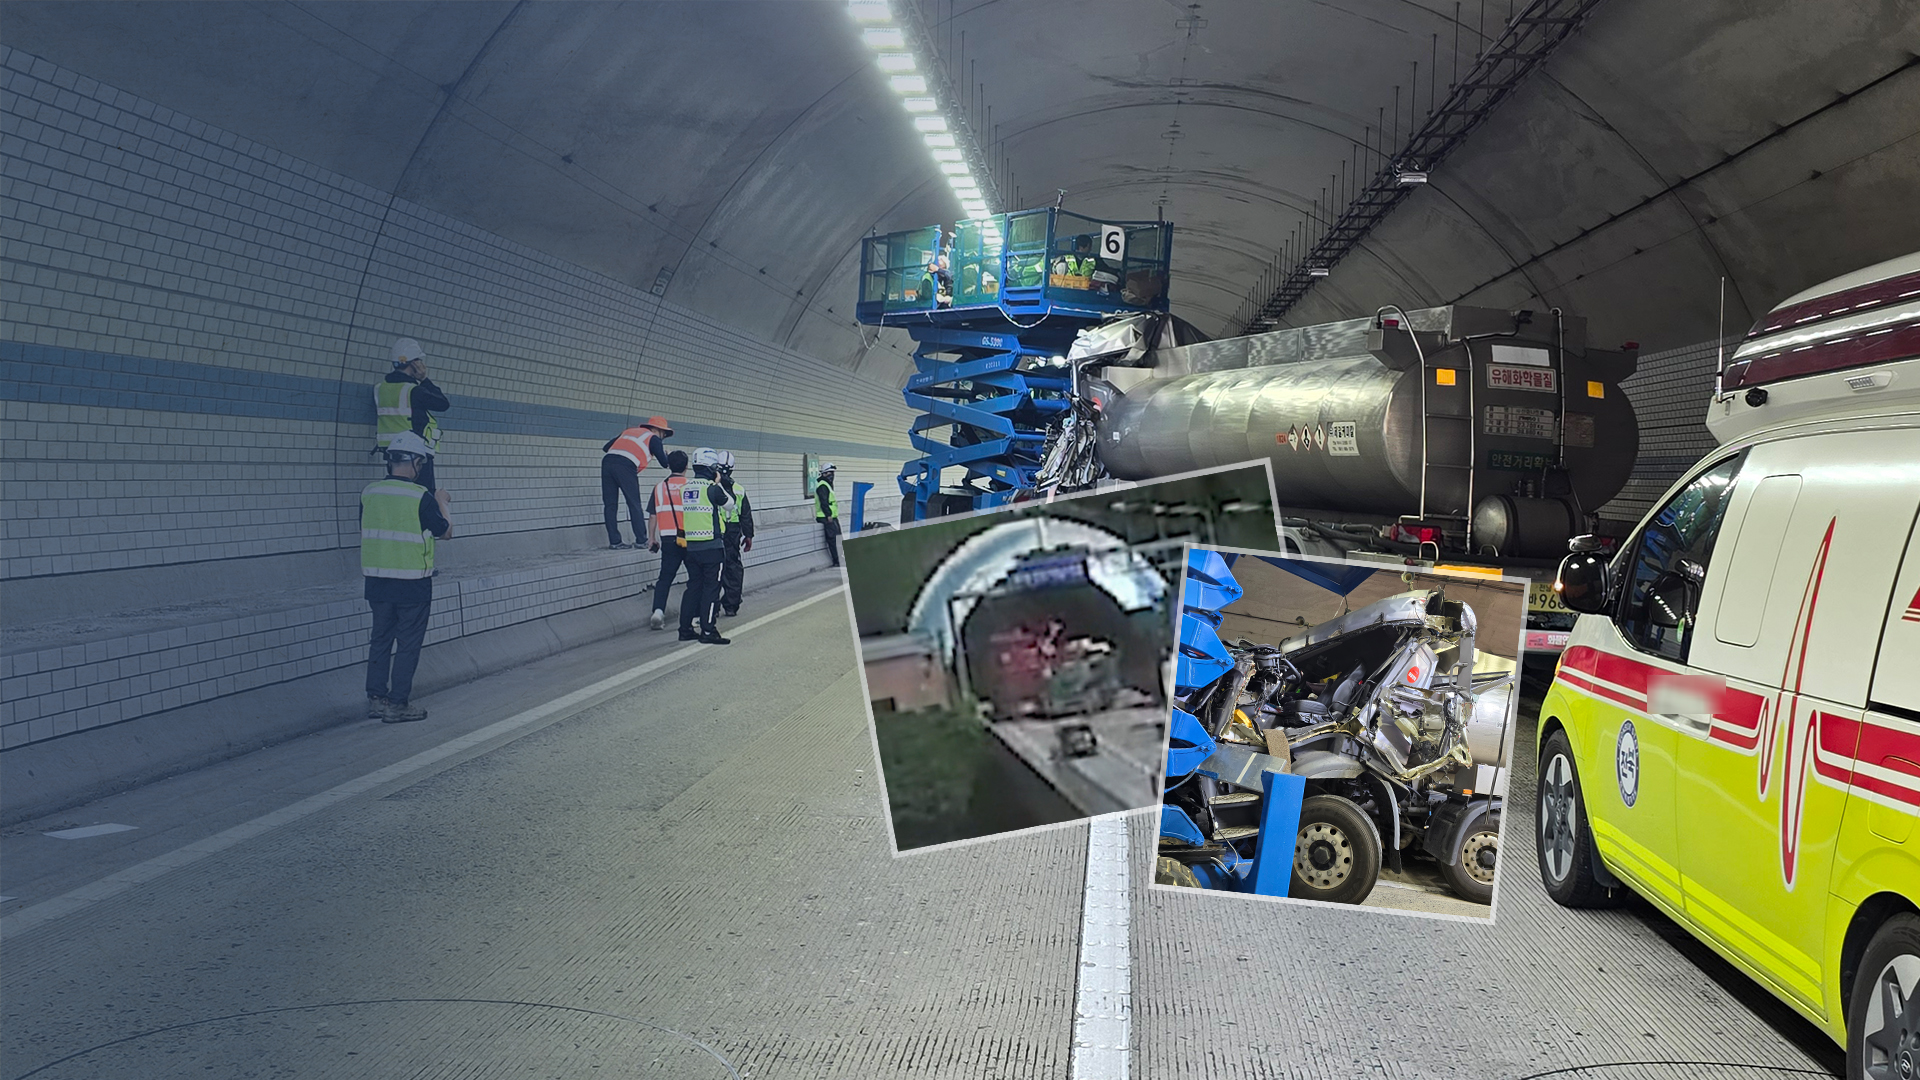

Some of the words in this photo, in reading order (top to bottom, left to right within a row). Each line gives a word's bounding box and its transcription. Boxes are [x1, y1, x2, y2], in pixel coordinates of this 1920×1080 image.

[1105, 231, 1120, 254] 6
[1491, 369, 1552, 388] 유해화학물질
[1621, 747, 1635, 779] 전북
